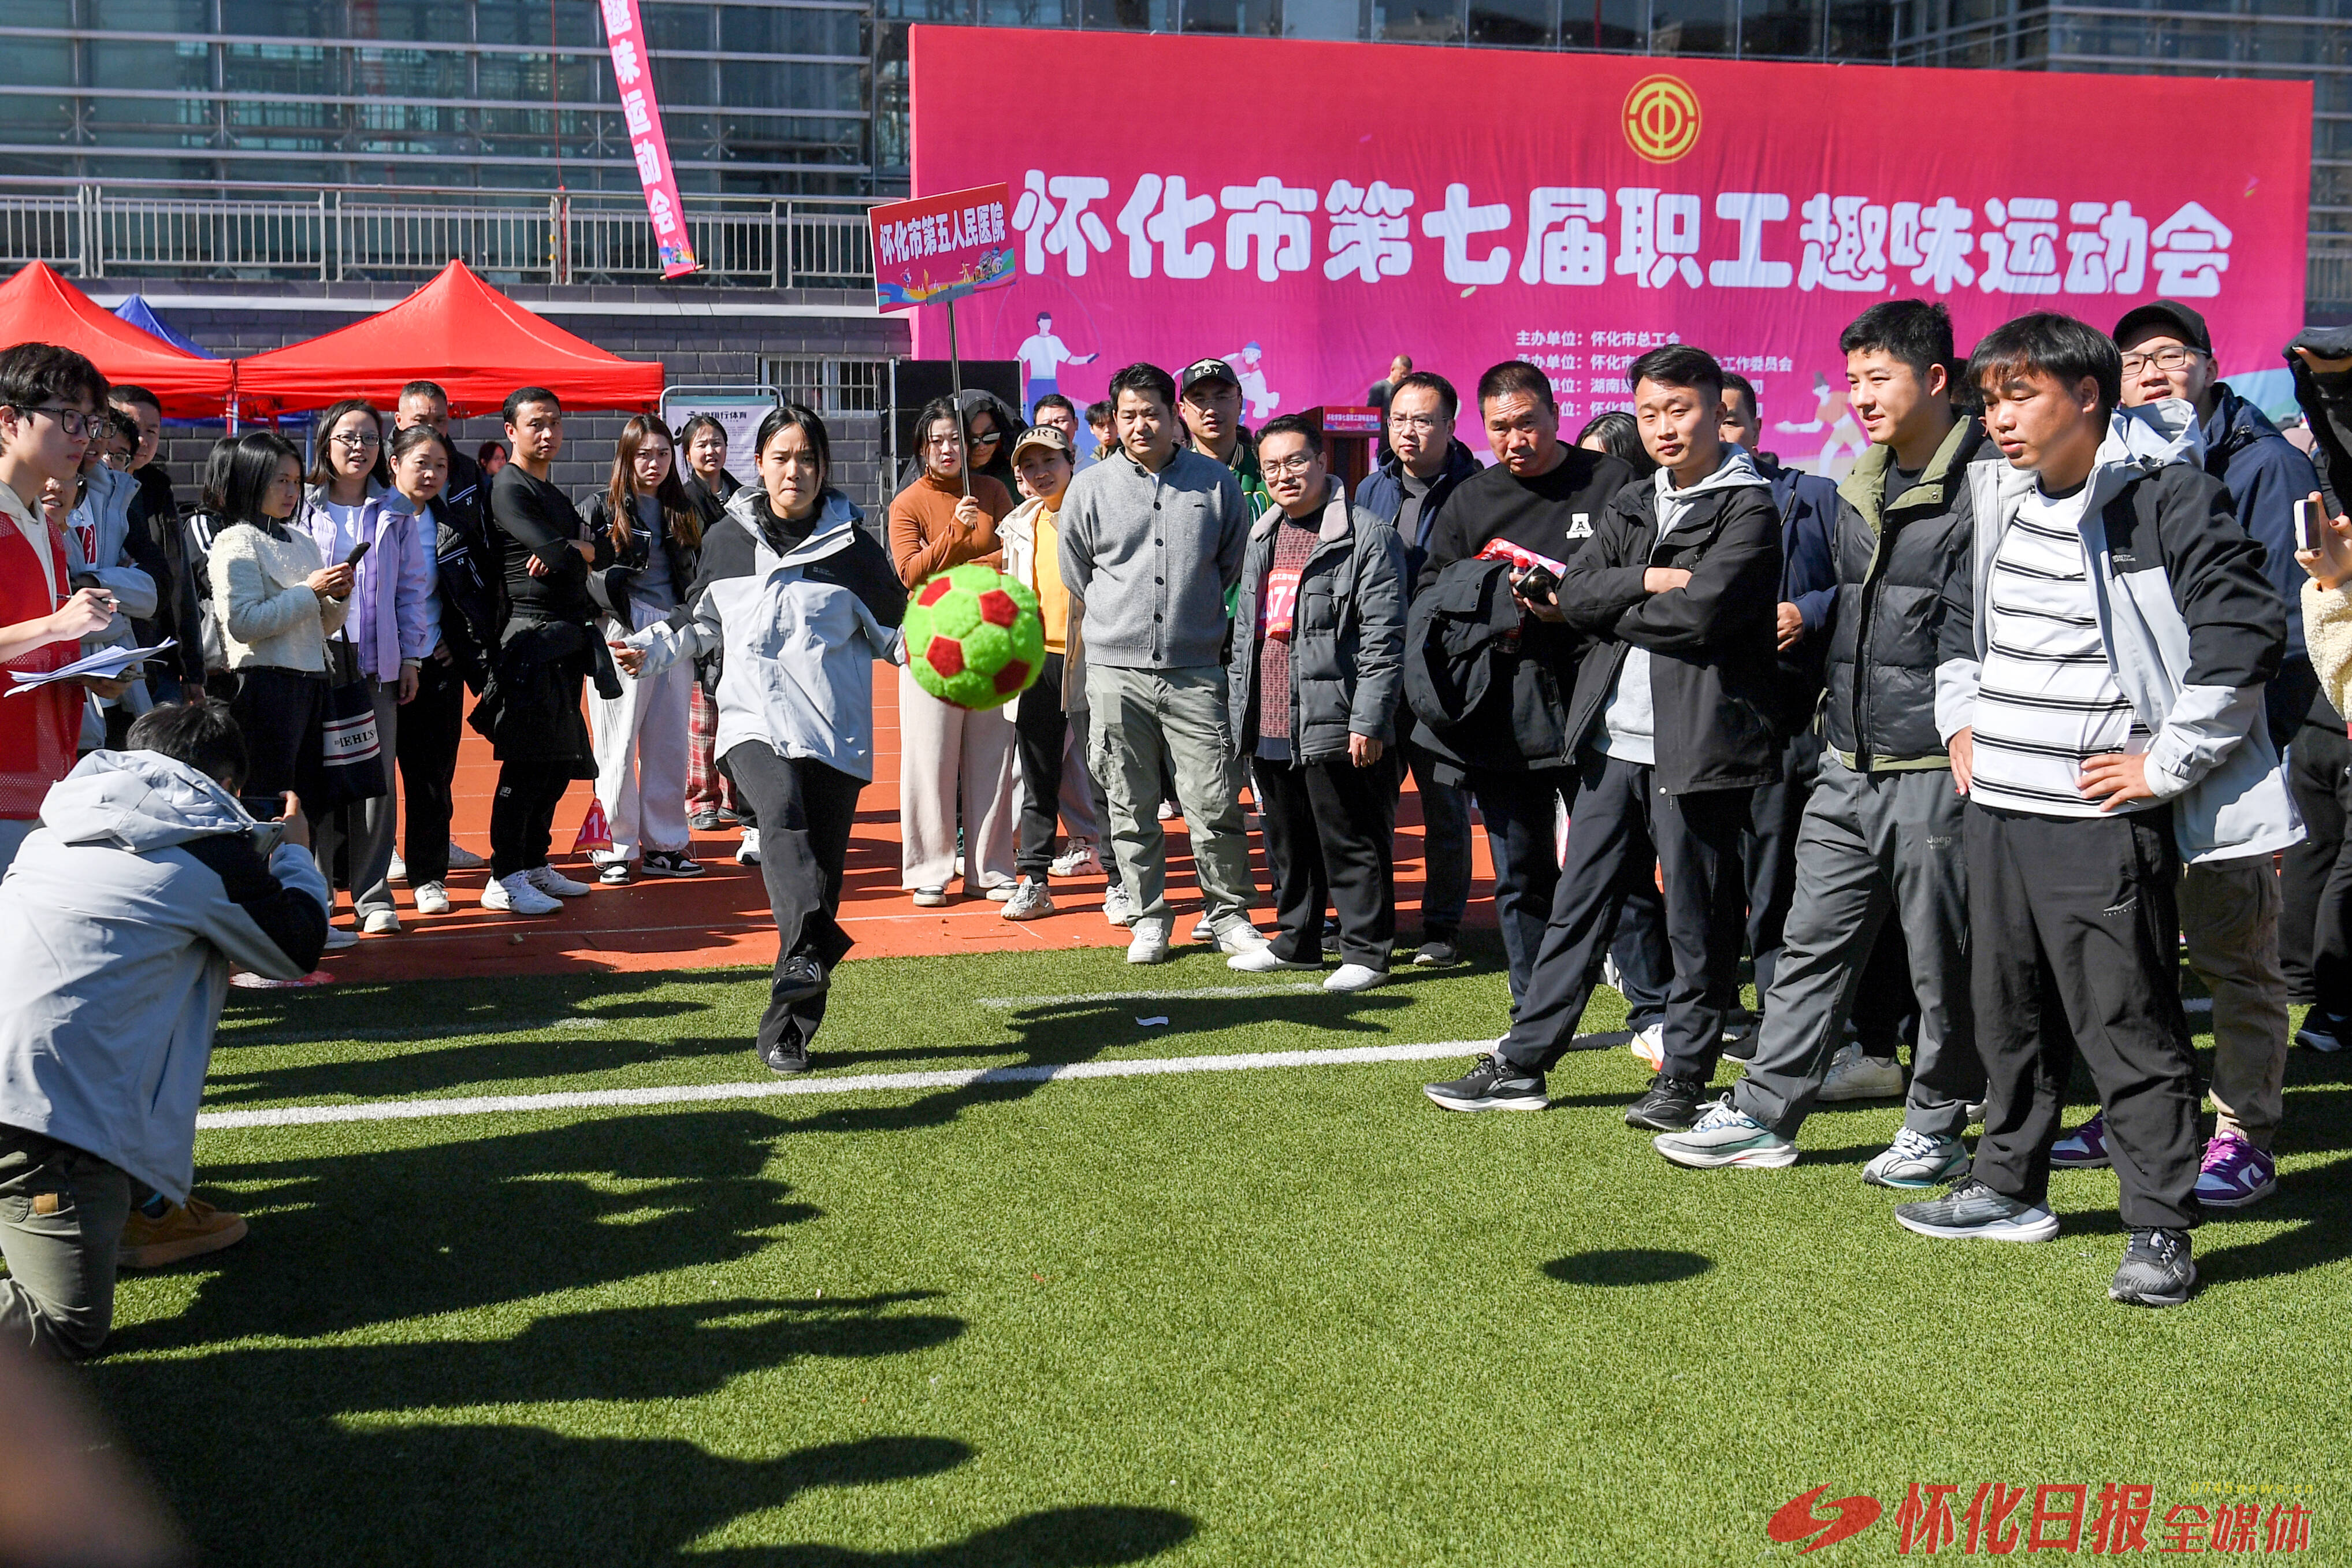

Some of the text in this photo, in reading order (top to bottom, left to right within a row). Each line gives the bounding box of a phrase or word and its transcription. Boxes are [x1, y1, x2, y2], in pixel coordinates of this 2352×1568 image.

[603, 0, 676, 235] 趣味运动会
[879, 200, 1006, 266] 怀化市第五人民医院
[1011, 169, 2233, 298] 怀化市第七届职工趣味运动会
[1195, 367, 1220, 377] BOY
[339, 729, 374, 748] IEHL'S
[1927, 835, 1951, 846] Jeep
